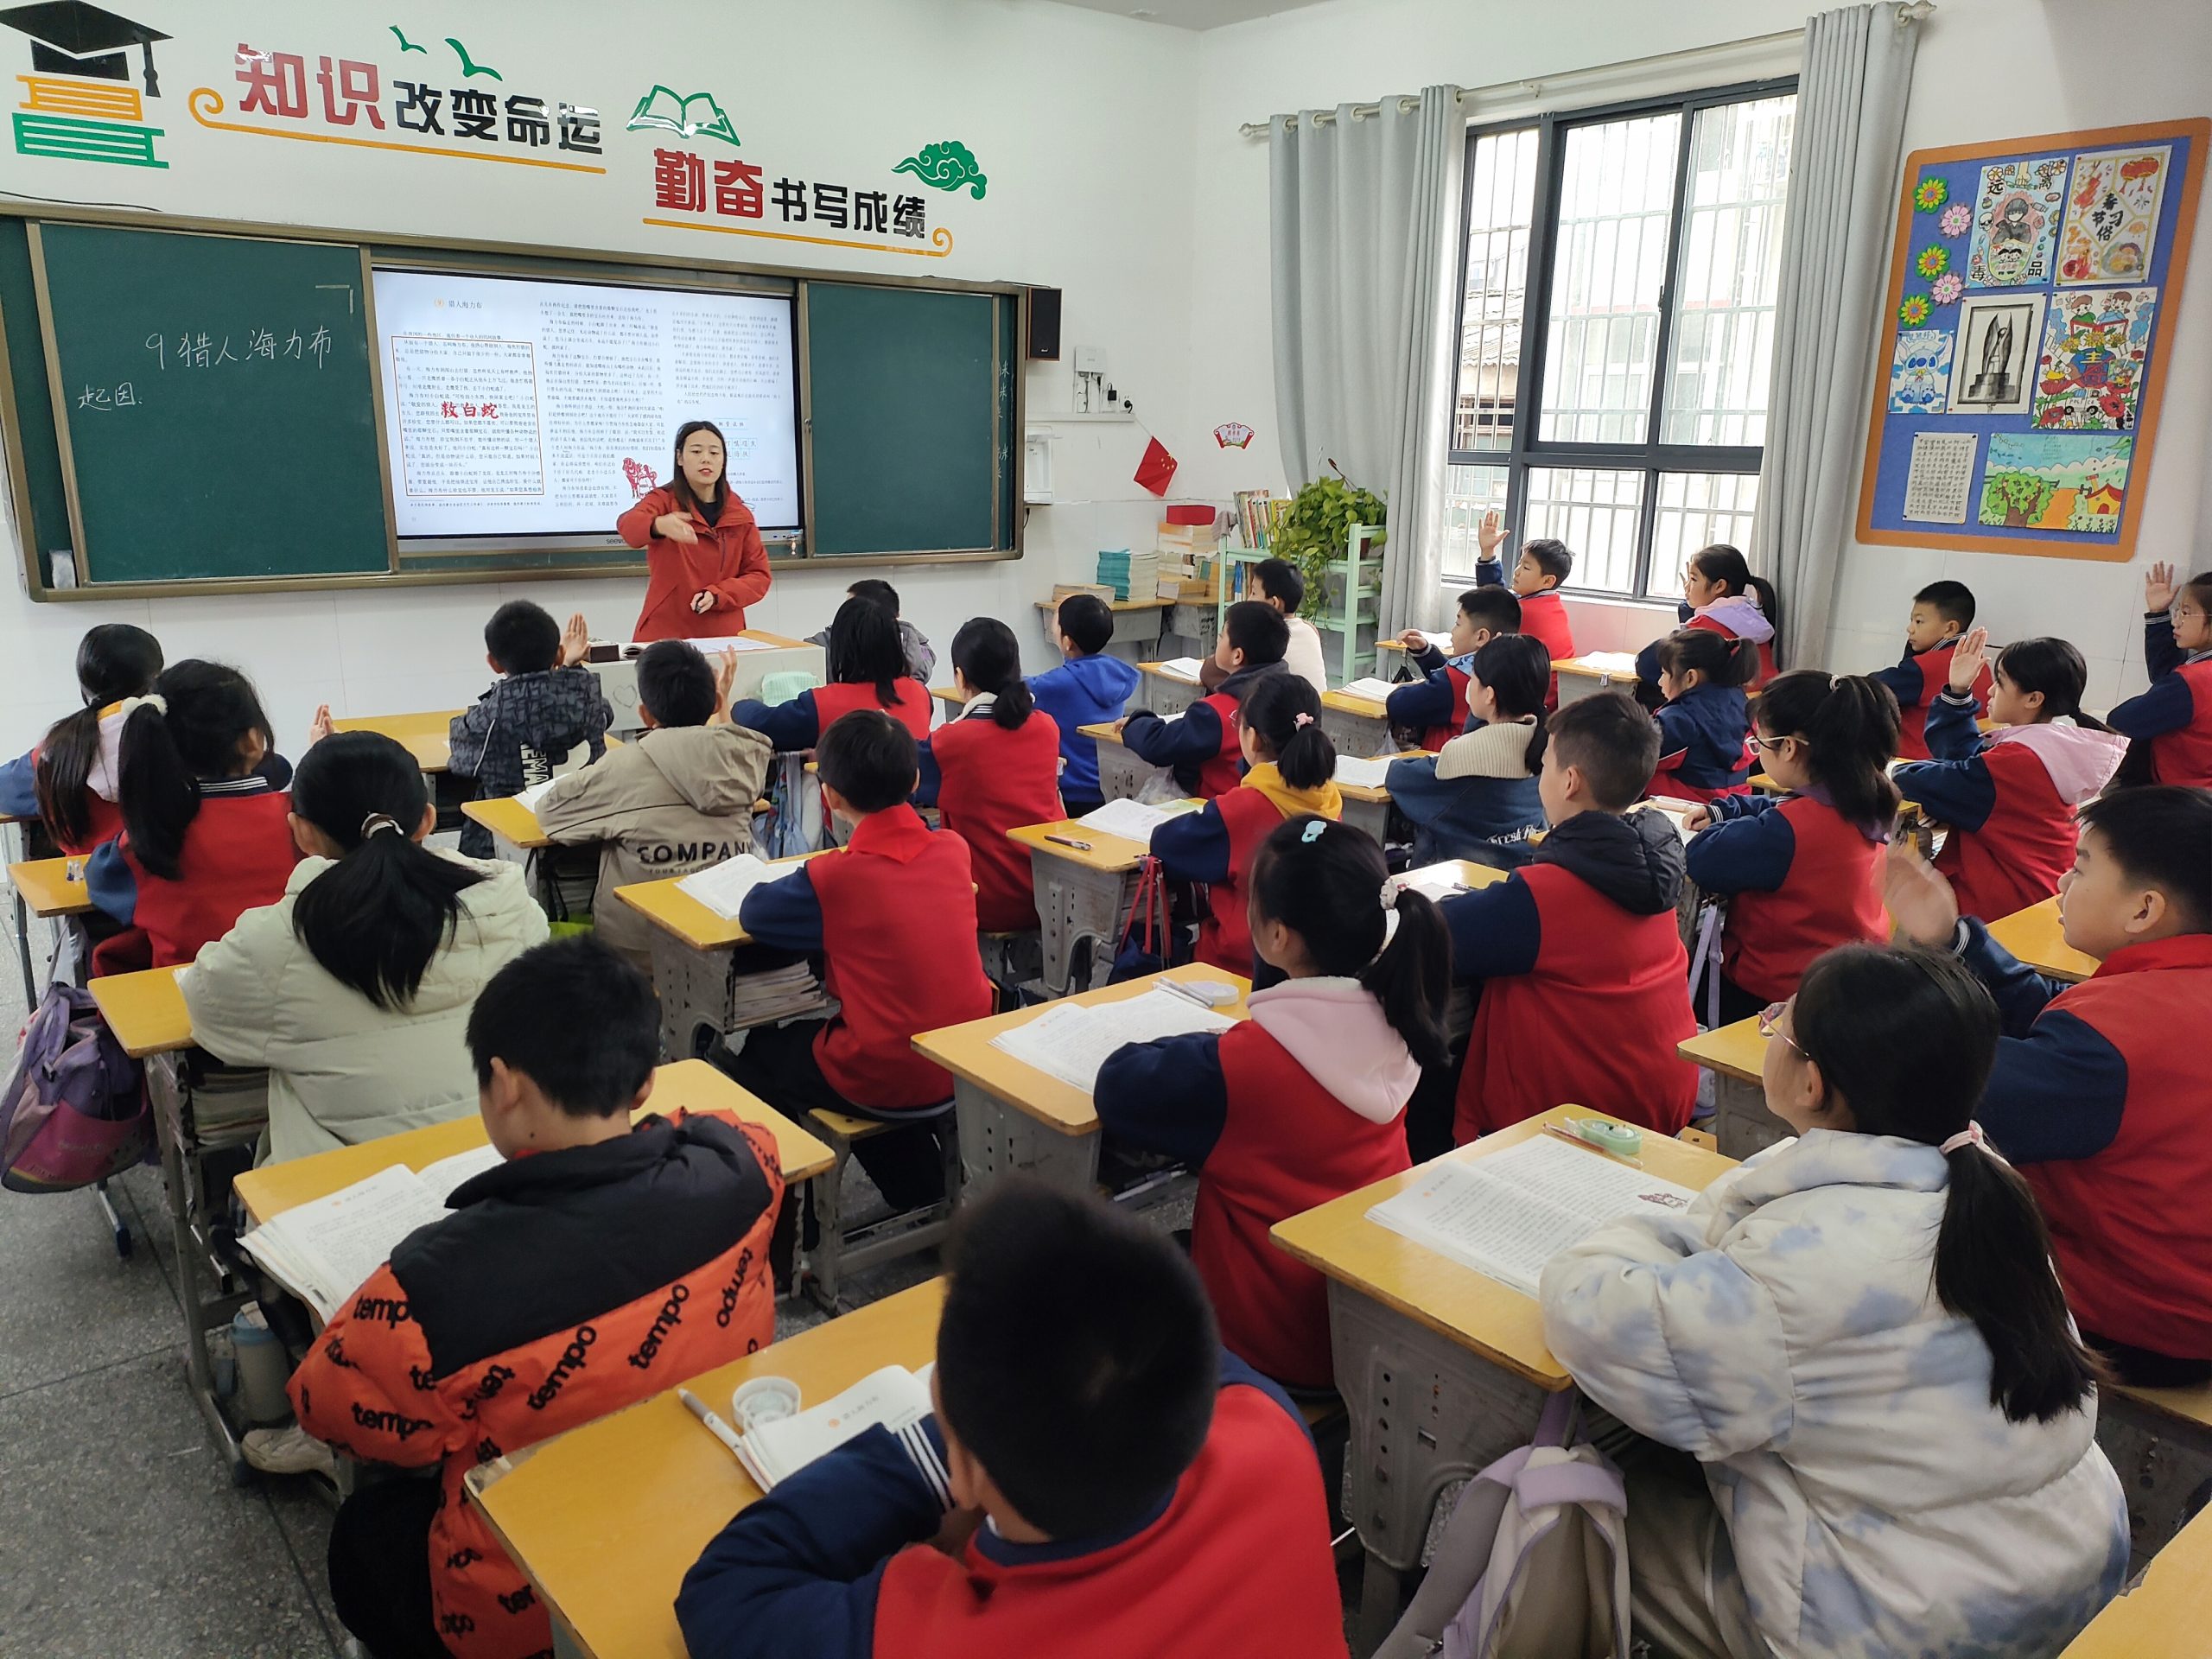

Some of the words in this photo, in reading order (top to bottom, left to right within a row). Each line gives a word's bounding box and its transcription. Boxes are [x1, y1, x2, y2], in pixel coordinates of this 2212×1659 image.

[235, 43, 602, 154] 知识改变命运
[653, 148, 925, 238] 勤奋书写成绩
[441, 400, 499, 419] 救白蛇
[628, 1284, 690, 1370] tempo
[716, 1247, 753, 1328] tempo
[527, 1325, 597, 1410] tempo
